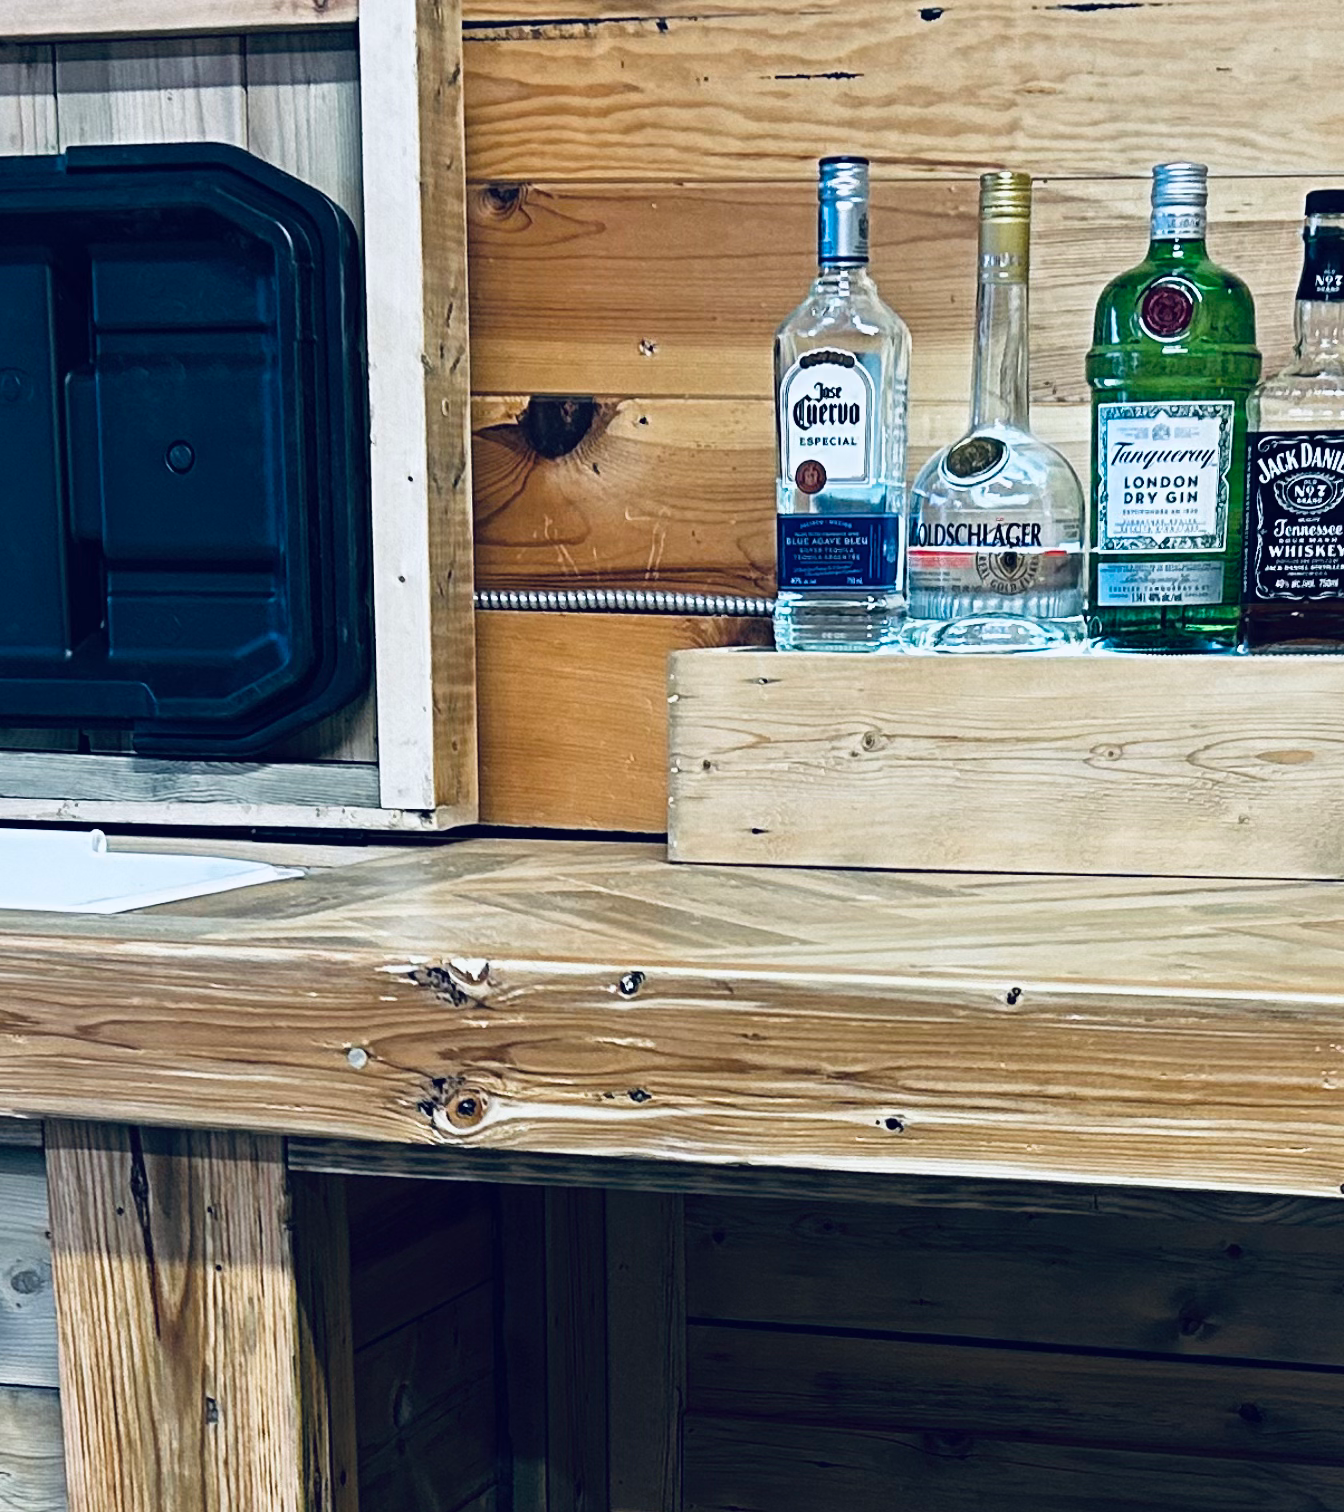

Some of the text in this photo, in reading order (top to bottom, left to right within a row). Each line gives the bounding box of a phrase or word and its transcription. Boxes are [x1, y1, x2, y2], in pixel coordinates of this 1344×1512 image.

[814, 381, 842, 403] Jose
[792, 394, 860, 431] Cuervo
[799, 436, 858, 446] ESPECIAL
[1110, 441, 1216, 470] Tanqueray
[1257, 448, 1299, 484] JACK
[1124, 475, 1198, 489] LONDON
[1123, 491, 1198, 504] DRY GIN
[1273, 518, 1344, 537] Tennessee
